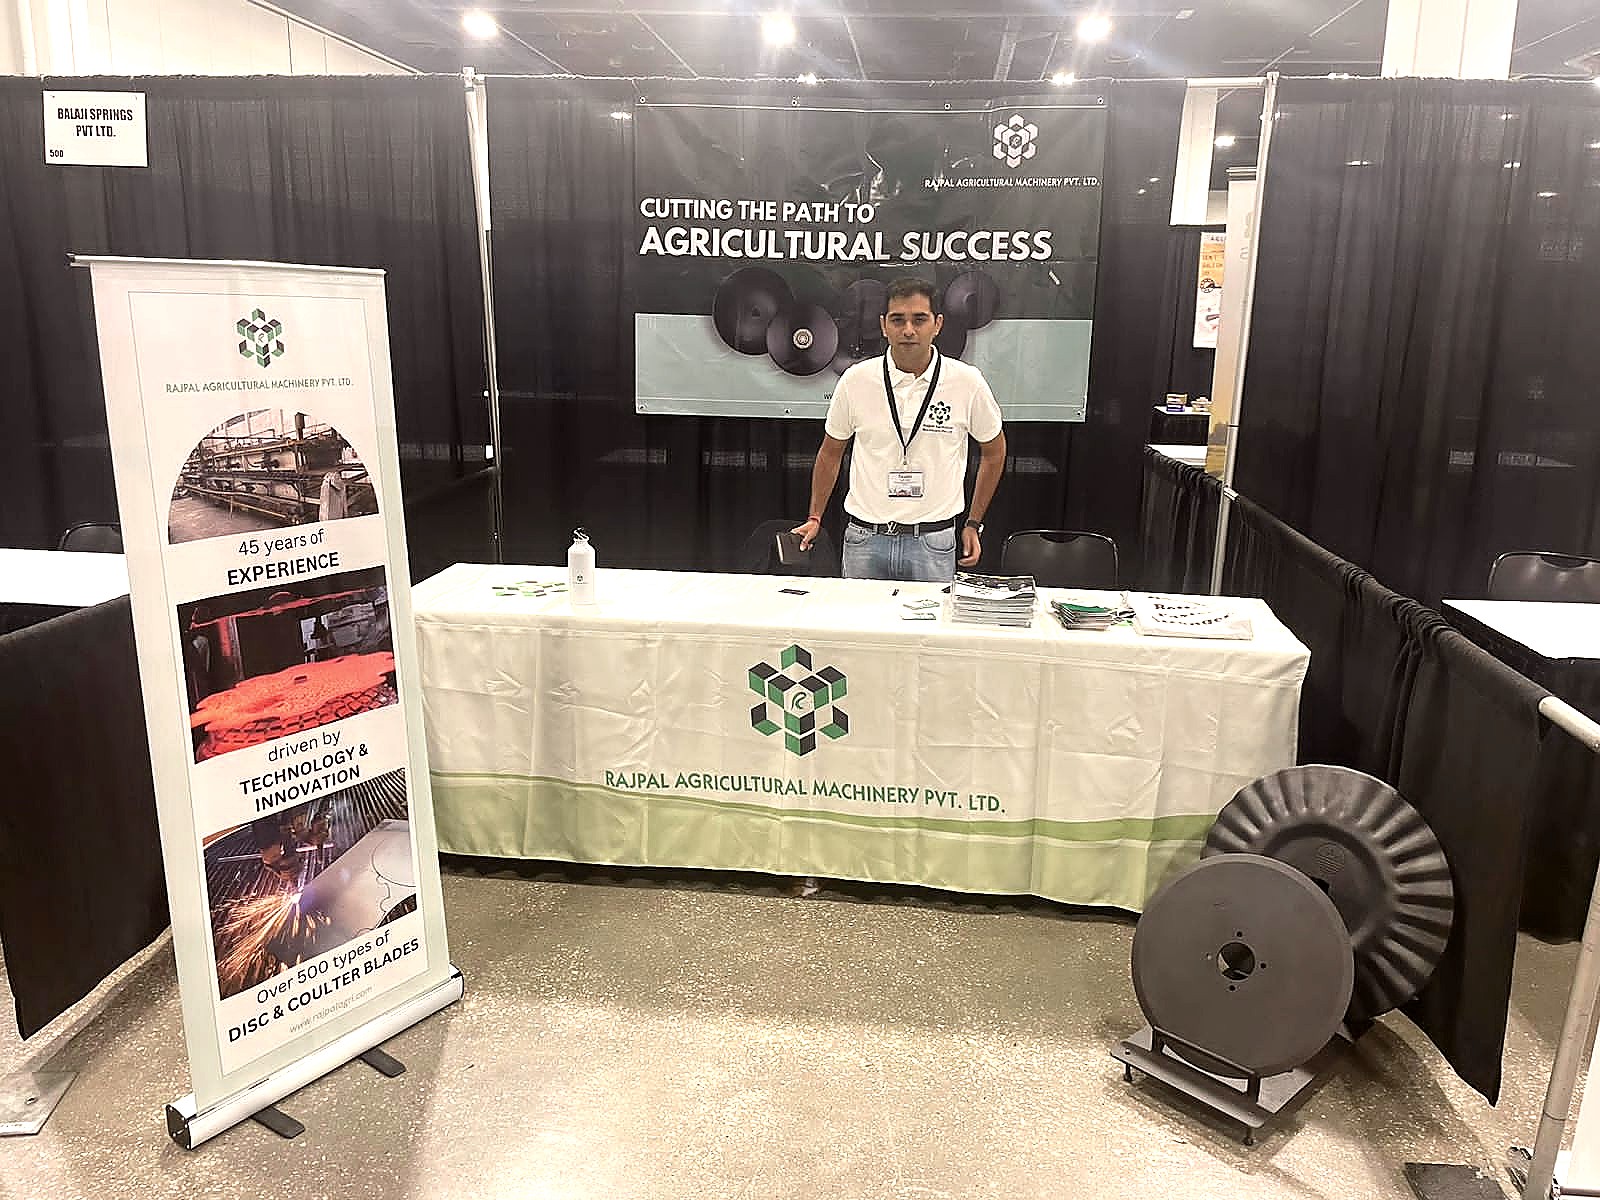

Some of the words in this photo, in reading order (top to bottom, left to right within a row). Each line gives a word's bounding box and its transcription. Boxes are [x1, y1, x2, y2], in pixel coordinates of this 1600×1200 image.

[57, 108, 88, 120] BALAJI
[89, 108, 133, 121] SPRINGS
[75, 125, 94, 137] PVT
[95, 125, 117, 137] LTD.
[924, 178, 955, 188] RAJPAL
[955, 178, 1013, 188] AGRICULTURAL
[1015, 178, 1062, 188] MACHINERY
[1063, 177, 1083, 187] PVT.
[1082, 178, 1101, 187] LTD.
[639, 198, 732, 220] CUTTING
[737, 201, 777, 221] THE
[782, 202, 838, 223] PATH
[842, 203, 875, 224] TO
[639, 226, 891, 260] AGRICULTURAL
[901, 231, 1054, 261] SUCCESS
[165, 382, 200, 394] RAJPAL
[202, 380, 270, 392] AGRICULTURAL
[271, 378, 320, 389] MACHINERY
[321, 378, 337, 387] PVT.
[338, 377, 355, 387] LTD.
[238, 540, 260, 556] 45
[263, 534, 307, 557] years
[310, 528, 324, 544] of
[227, 552, 340, 586] EXPERIENCE
[268, 738, 318, 762] driven
[322, 730, 341, 746] by
[239, 746, 355, 795] TECHNOLOGY
[358, 743, 369, 757] &
[255, 765, 360, 812] INNOVATION
[605, 770, 670, 788] RAJPAL
[674, 772, 809, 796] AGRICULTURAL
[812, 780, 920, 805] MACHINERY
[923, 788, 963, 810] PVT.
[968, 794, 1007, 814] LTD.
[256, 977, 294, 1004] Over
[296, 959, 330, 984] 500
[333, 941, 372, 970] types
[374, 929, 391, 948] of
[228, 1012, 270, 1043] DISC
[272, 1005, 285, 1020] &
[287, 966, 361, 1013] COULTER
[363, 938, 420, 976] BLADES
